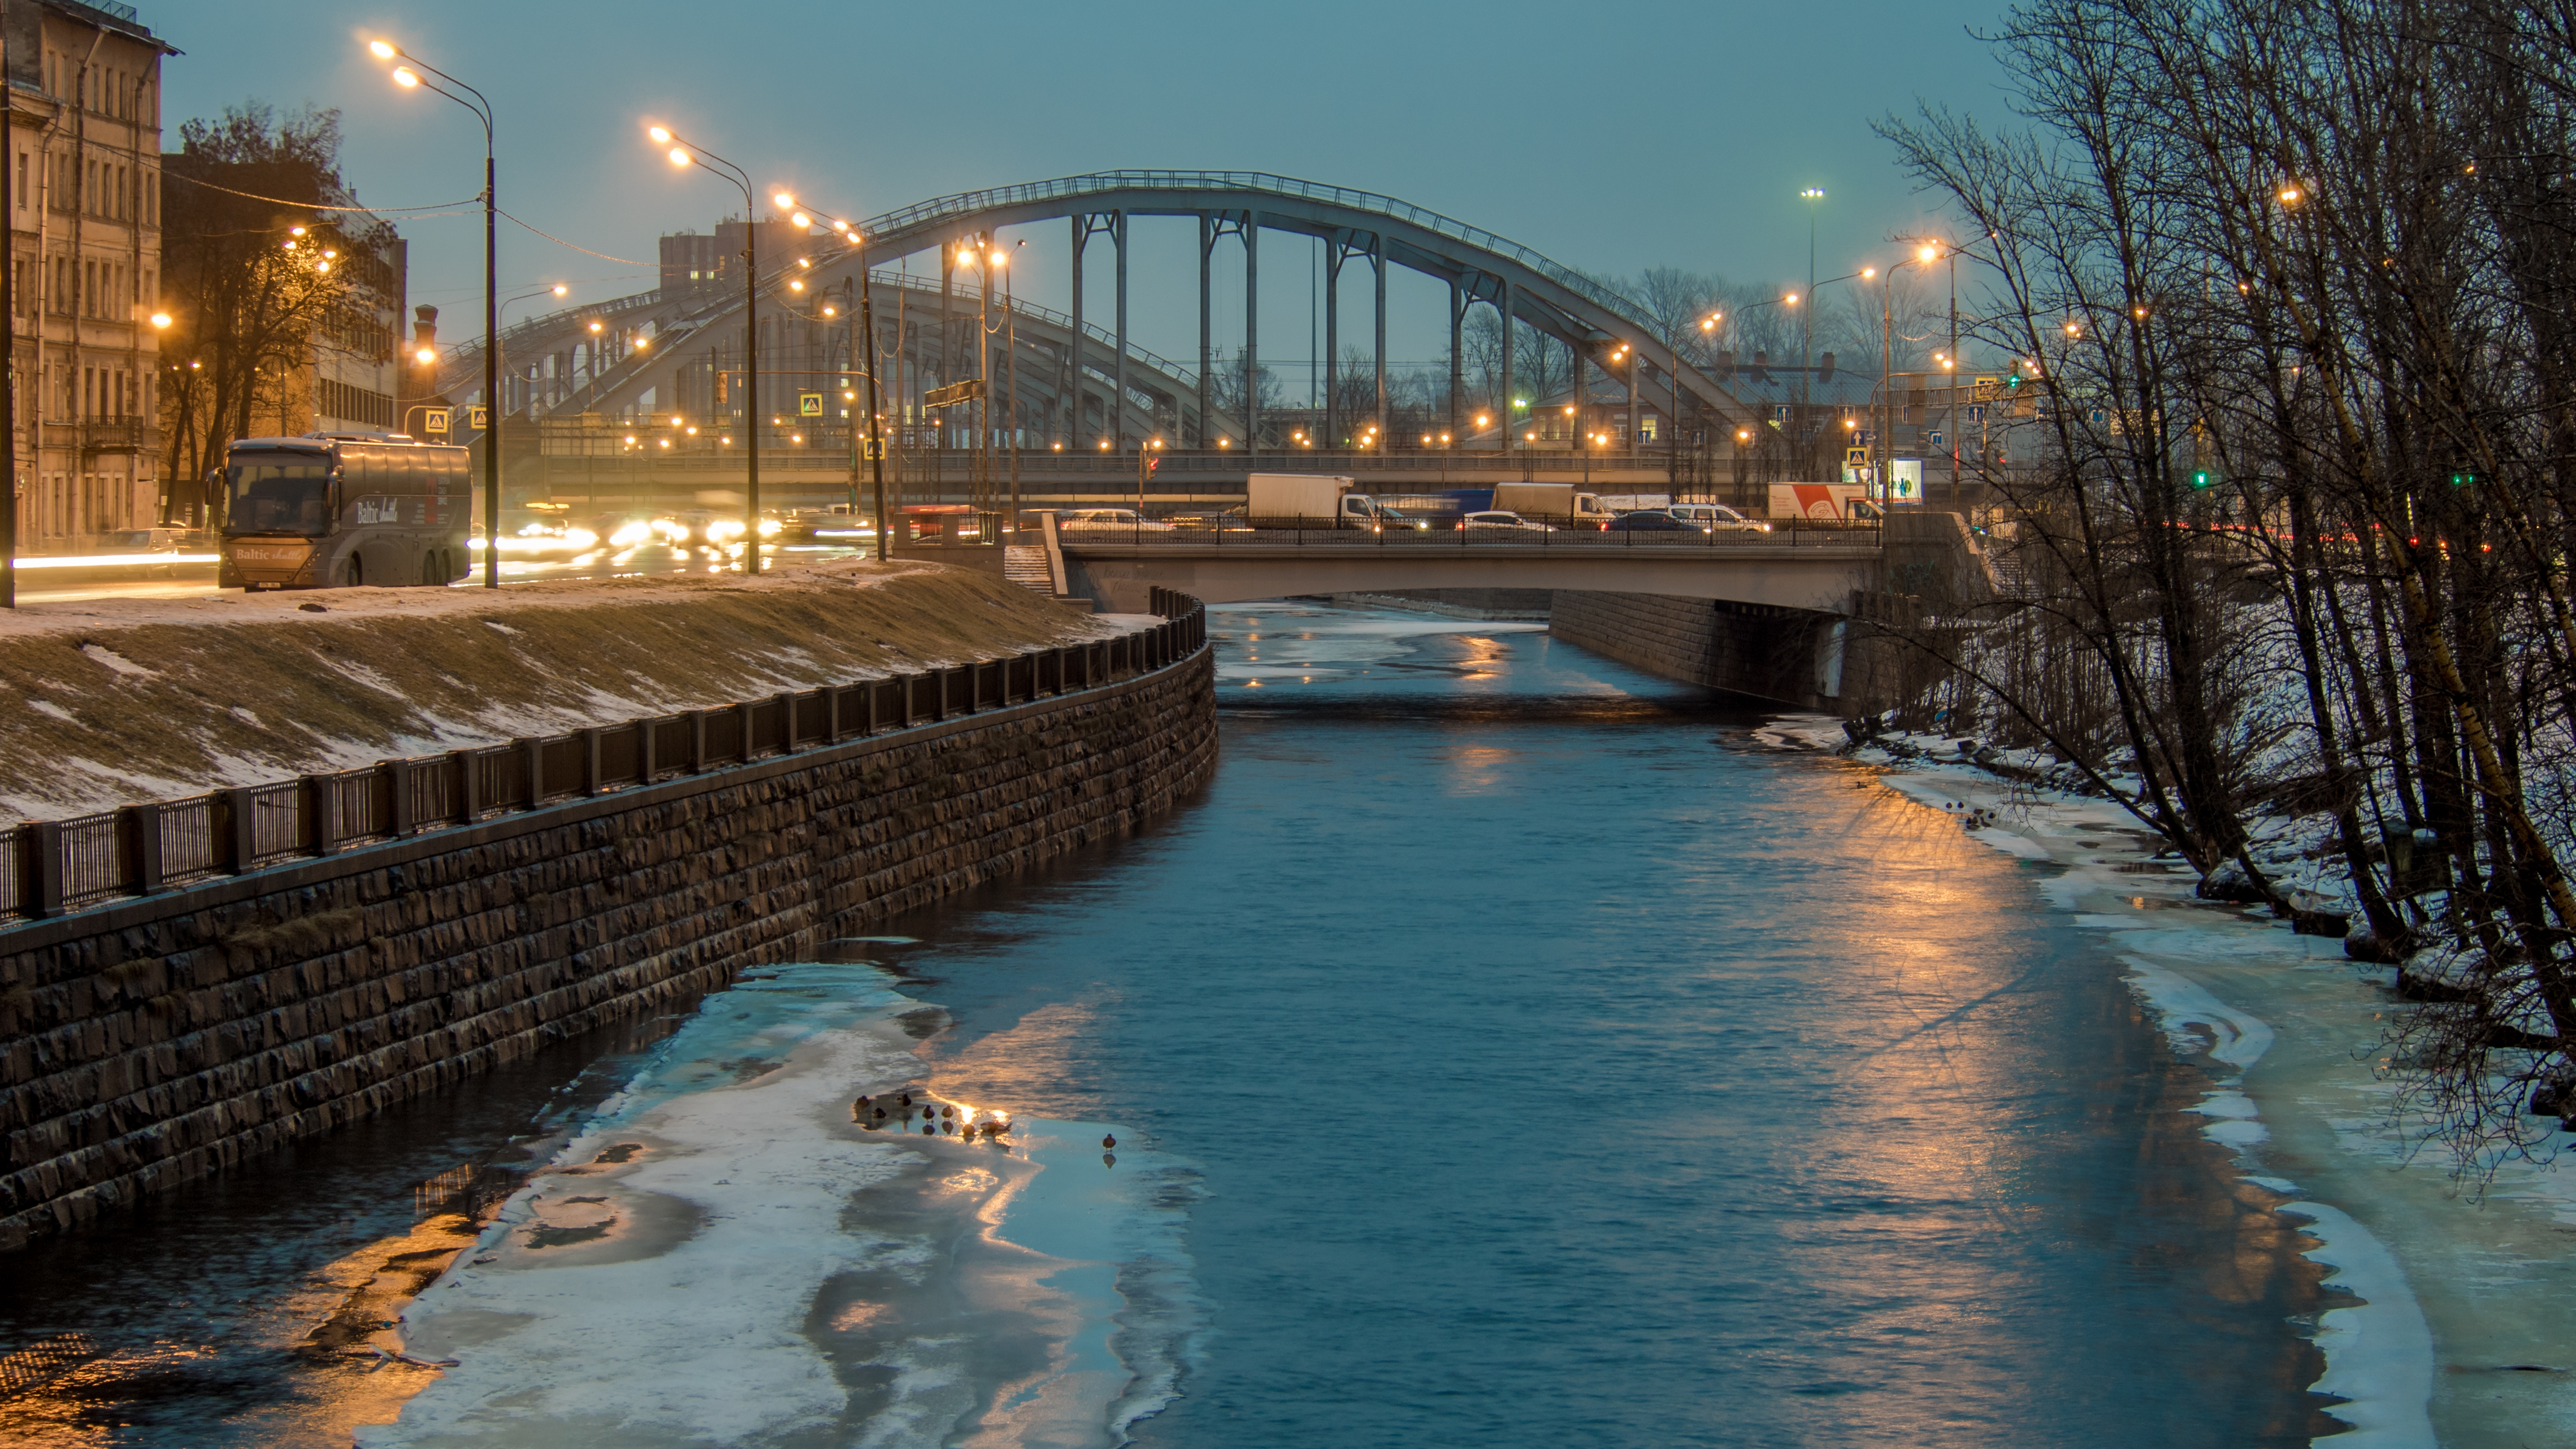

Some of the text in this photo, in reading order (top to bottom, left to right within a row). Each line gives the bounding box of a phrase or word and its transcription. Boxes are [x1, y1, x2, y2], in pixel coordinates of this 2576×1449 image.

[357, 501, 378, 524] Baltic
[379, 497, 398, 523] shuttle
[236, 548, 303, 560] Baltic shuttle
